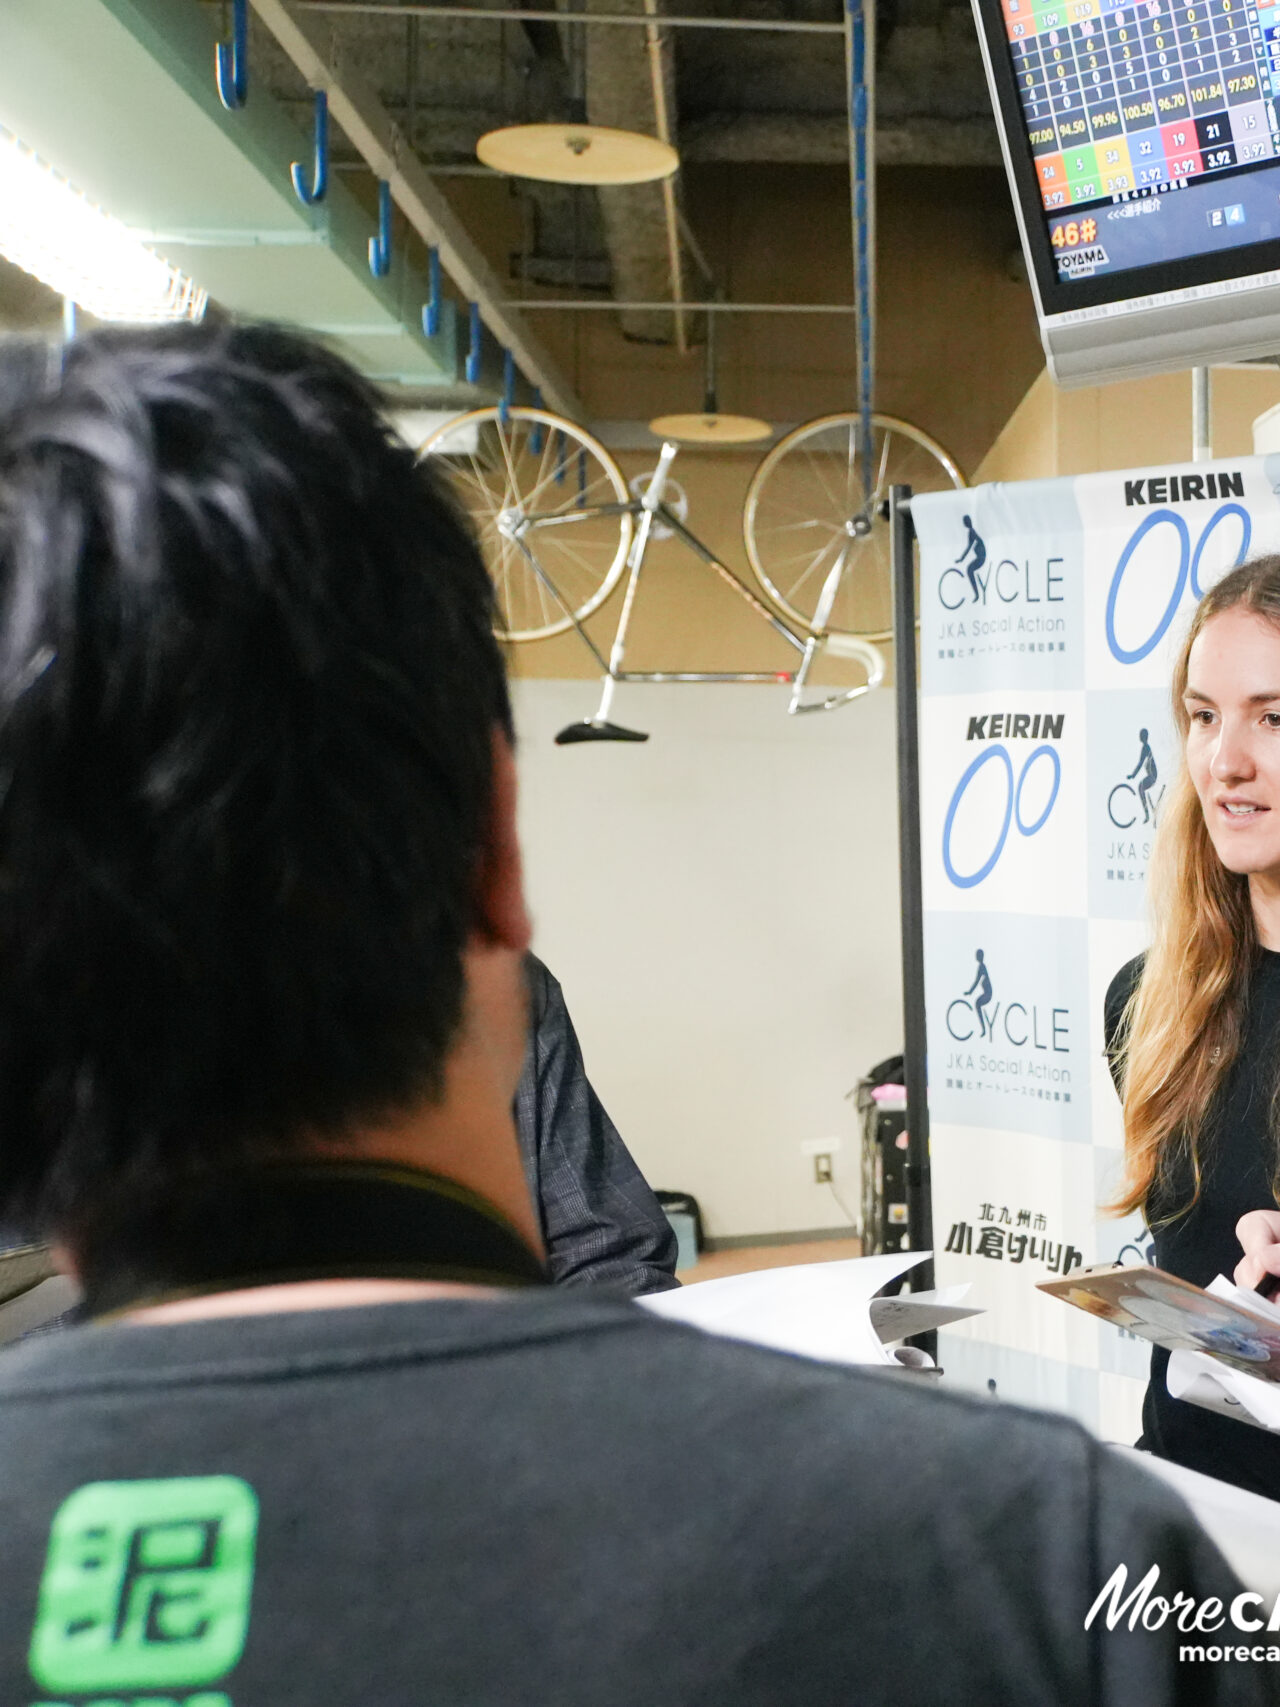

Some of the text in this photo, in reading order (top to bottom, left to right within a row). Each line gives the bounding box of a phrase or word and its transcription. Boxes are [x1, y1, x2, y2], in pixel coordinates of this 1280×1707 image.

[1013, 24, 1025, 36] 93
[1042, 13, 1058, 27] 109
[1074, 3, 1092, 17] 119
[1053, 48, 1061, 60] 0
[1087, 38, 1094, 52] 6
[1119, 29, 1127, 42] 0
[1153, 19, 1160, 33] 6
[1187, 9, 1195, 22] 0
[1025, 73, 1034, 87] 0
[1056, 64, 1065, 78] 0
[1089, 55, 1098, 69] 3
[1122, 46, 1131, 59] 3
[1156, 36, 1164, 49] 0
[1190, 26, 1199, 40] 2
[1029, 88, 1037, 101] 4
[1060, 80, 1068, 93] 2
[1092, 70, 1100, 84] 0
[1125, 61, 1134, 75] 5
[1159, 52, 1167, 65] 0
[1229, 32, 1237, 46] 3
[1063, 95, 1071, 109] 0
[1162, 68, 1170, 82] 0
[1232, 49, 1241, 63] 2
[1029, 127, 1055, 146] 97.00
[1059, 119, 1086, 137] 94.50
[1091, 111, 1118, 129] 99.96
[1123, 101, 1153, 121] 100.50
[1157, 93, 1186, 112] 96.70
[1191, 83, 1223, 103] 101.84
[1227, 75, 1256, 94] 97.30
[1042, 166, 1055, 179] 24
[1076, 158, 1083, 172] 5
[1105, 150, 1120, 164] 34
[1139, 141, 1152, 156] 32
[1172, 133, 1185, 147] 19
[1206, 123, 1220, 139] 21
[1243, 115, 1256, 129] 15
[1044, 191, 1064, 207] 3.92
[1075, 183, 1096, 199] 3.92
[1107, 175, 1129, 191] 3.93
[1140, 167, 1162, 184] 3.92
[1173, 159, 1196, 177] 3.92
[1207, 150, 1231, 168] 3.92
[1243, 142, 1266, 159] 3.92
[1051, 218, 1097, 248] 46#
[1125, 472, 1245, 506] KEIRIN
[938, 558, 1064, 610] CYCLE
[938, 616, 1065, 640] JKA Social Action
[966, 713, 1065, 740] KEIRIN
[1107, 842, 1136, 859] JKA
[946, 999, 1070, 1053] CYCLE
[946, 1054, 1072, 1083] JKA Social Action
[977, 1202, 1048, 1232] 北九州市
